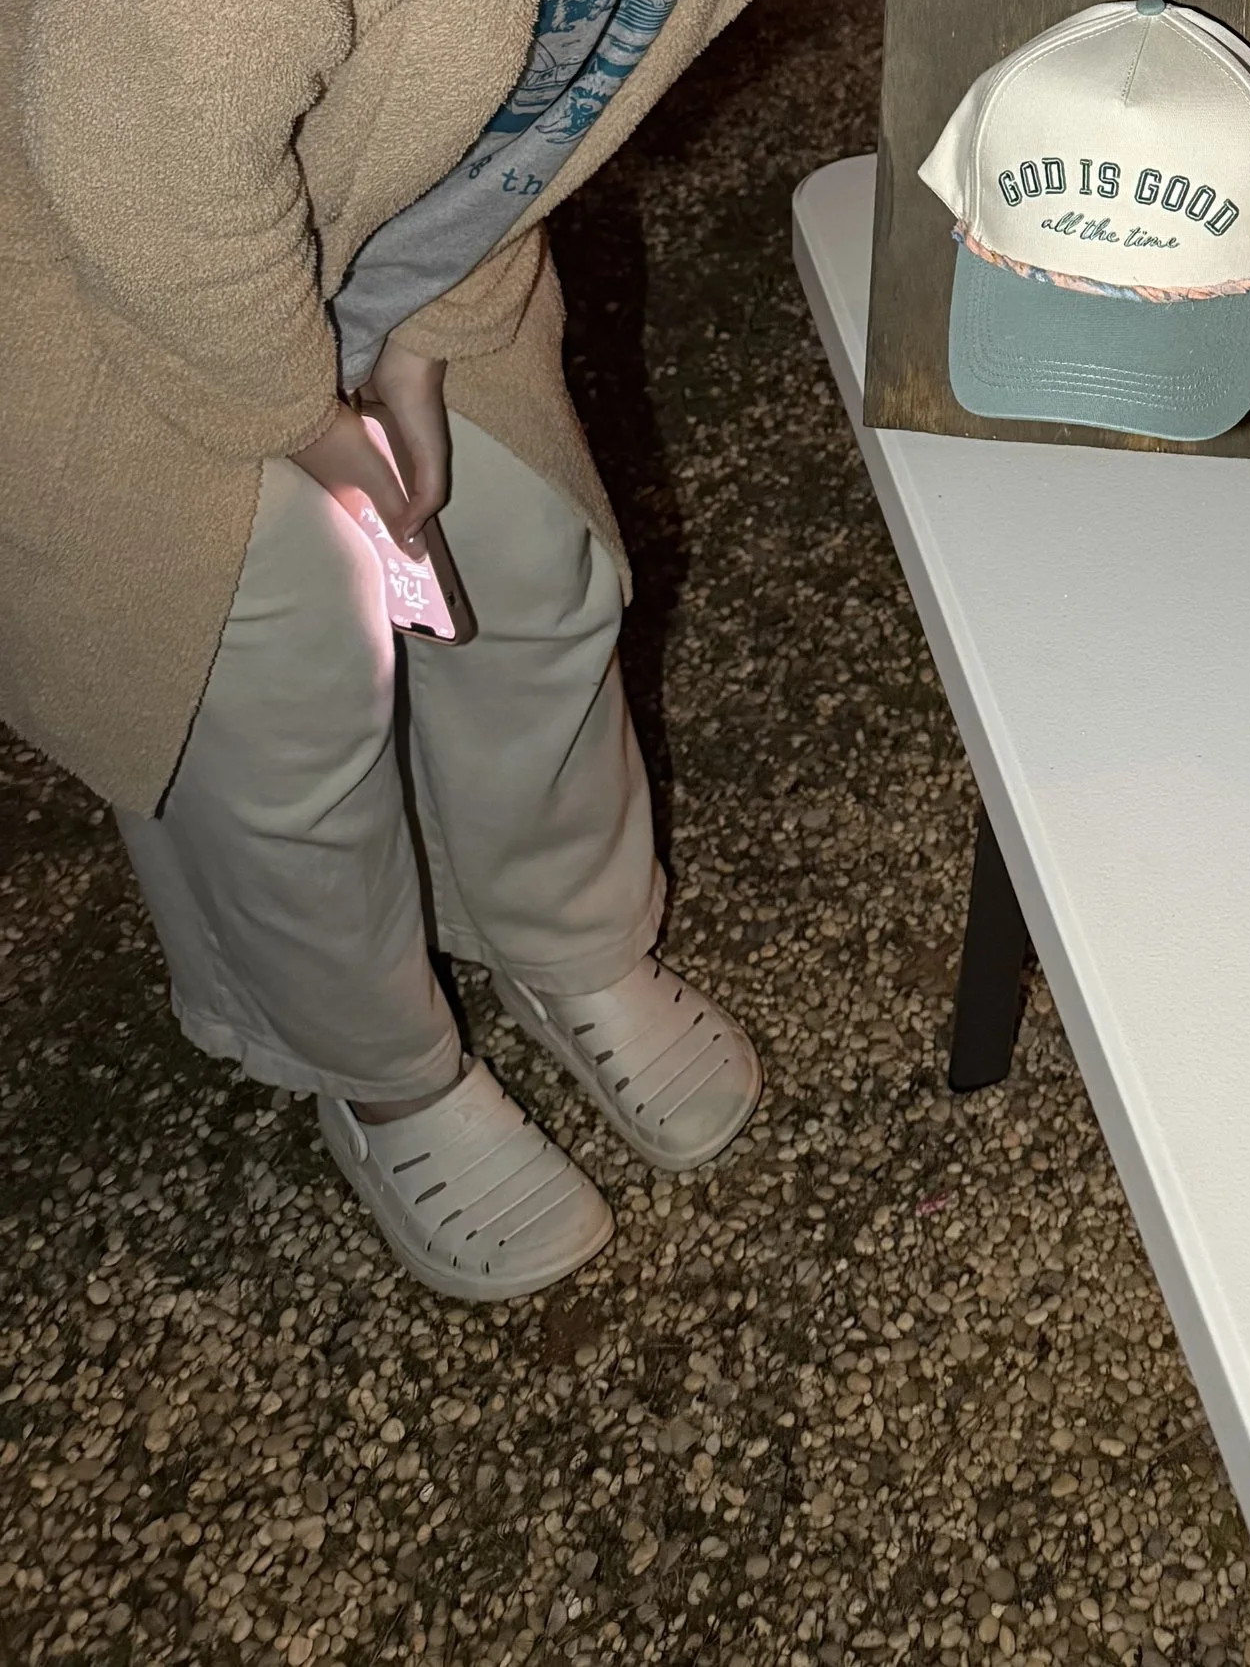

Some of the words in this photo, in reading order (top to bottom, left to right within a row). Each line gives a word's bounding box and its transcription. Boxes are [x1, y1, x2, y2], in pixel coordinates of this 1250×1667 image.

[998, 157, 1067, 207] GOD
[1079, 159, 1121, 199] IS
[1134, 168, 1240, 237] GOOD
[1041, 211, 1085, 236] all
[1079, 217, 1120, 243] the
[1124, 226, 1181, 250] time
